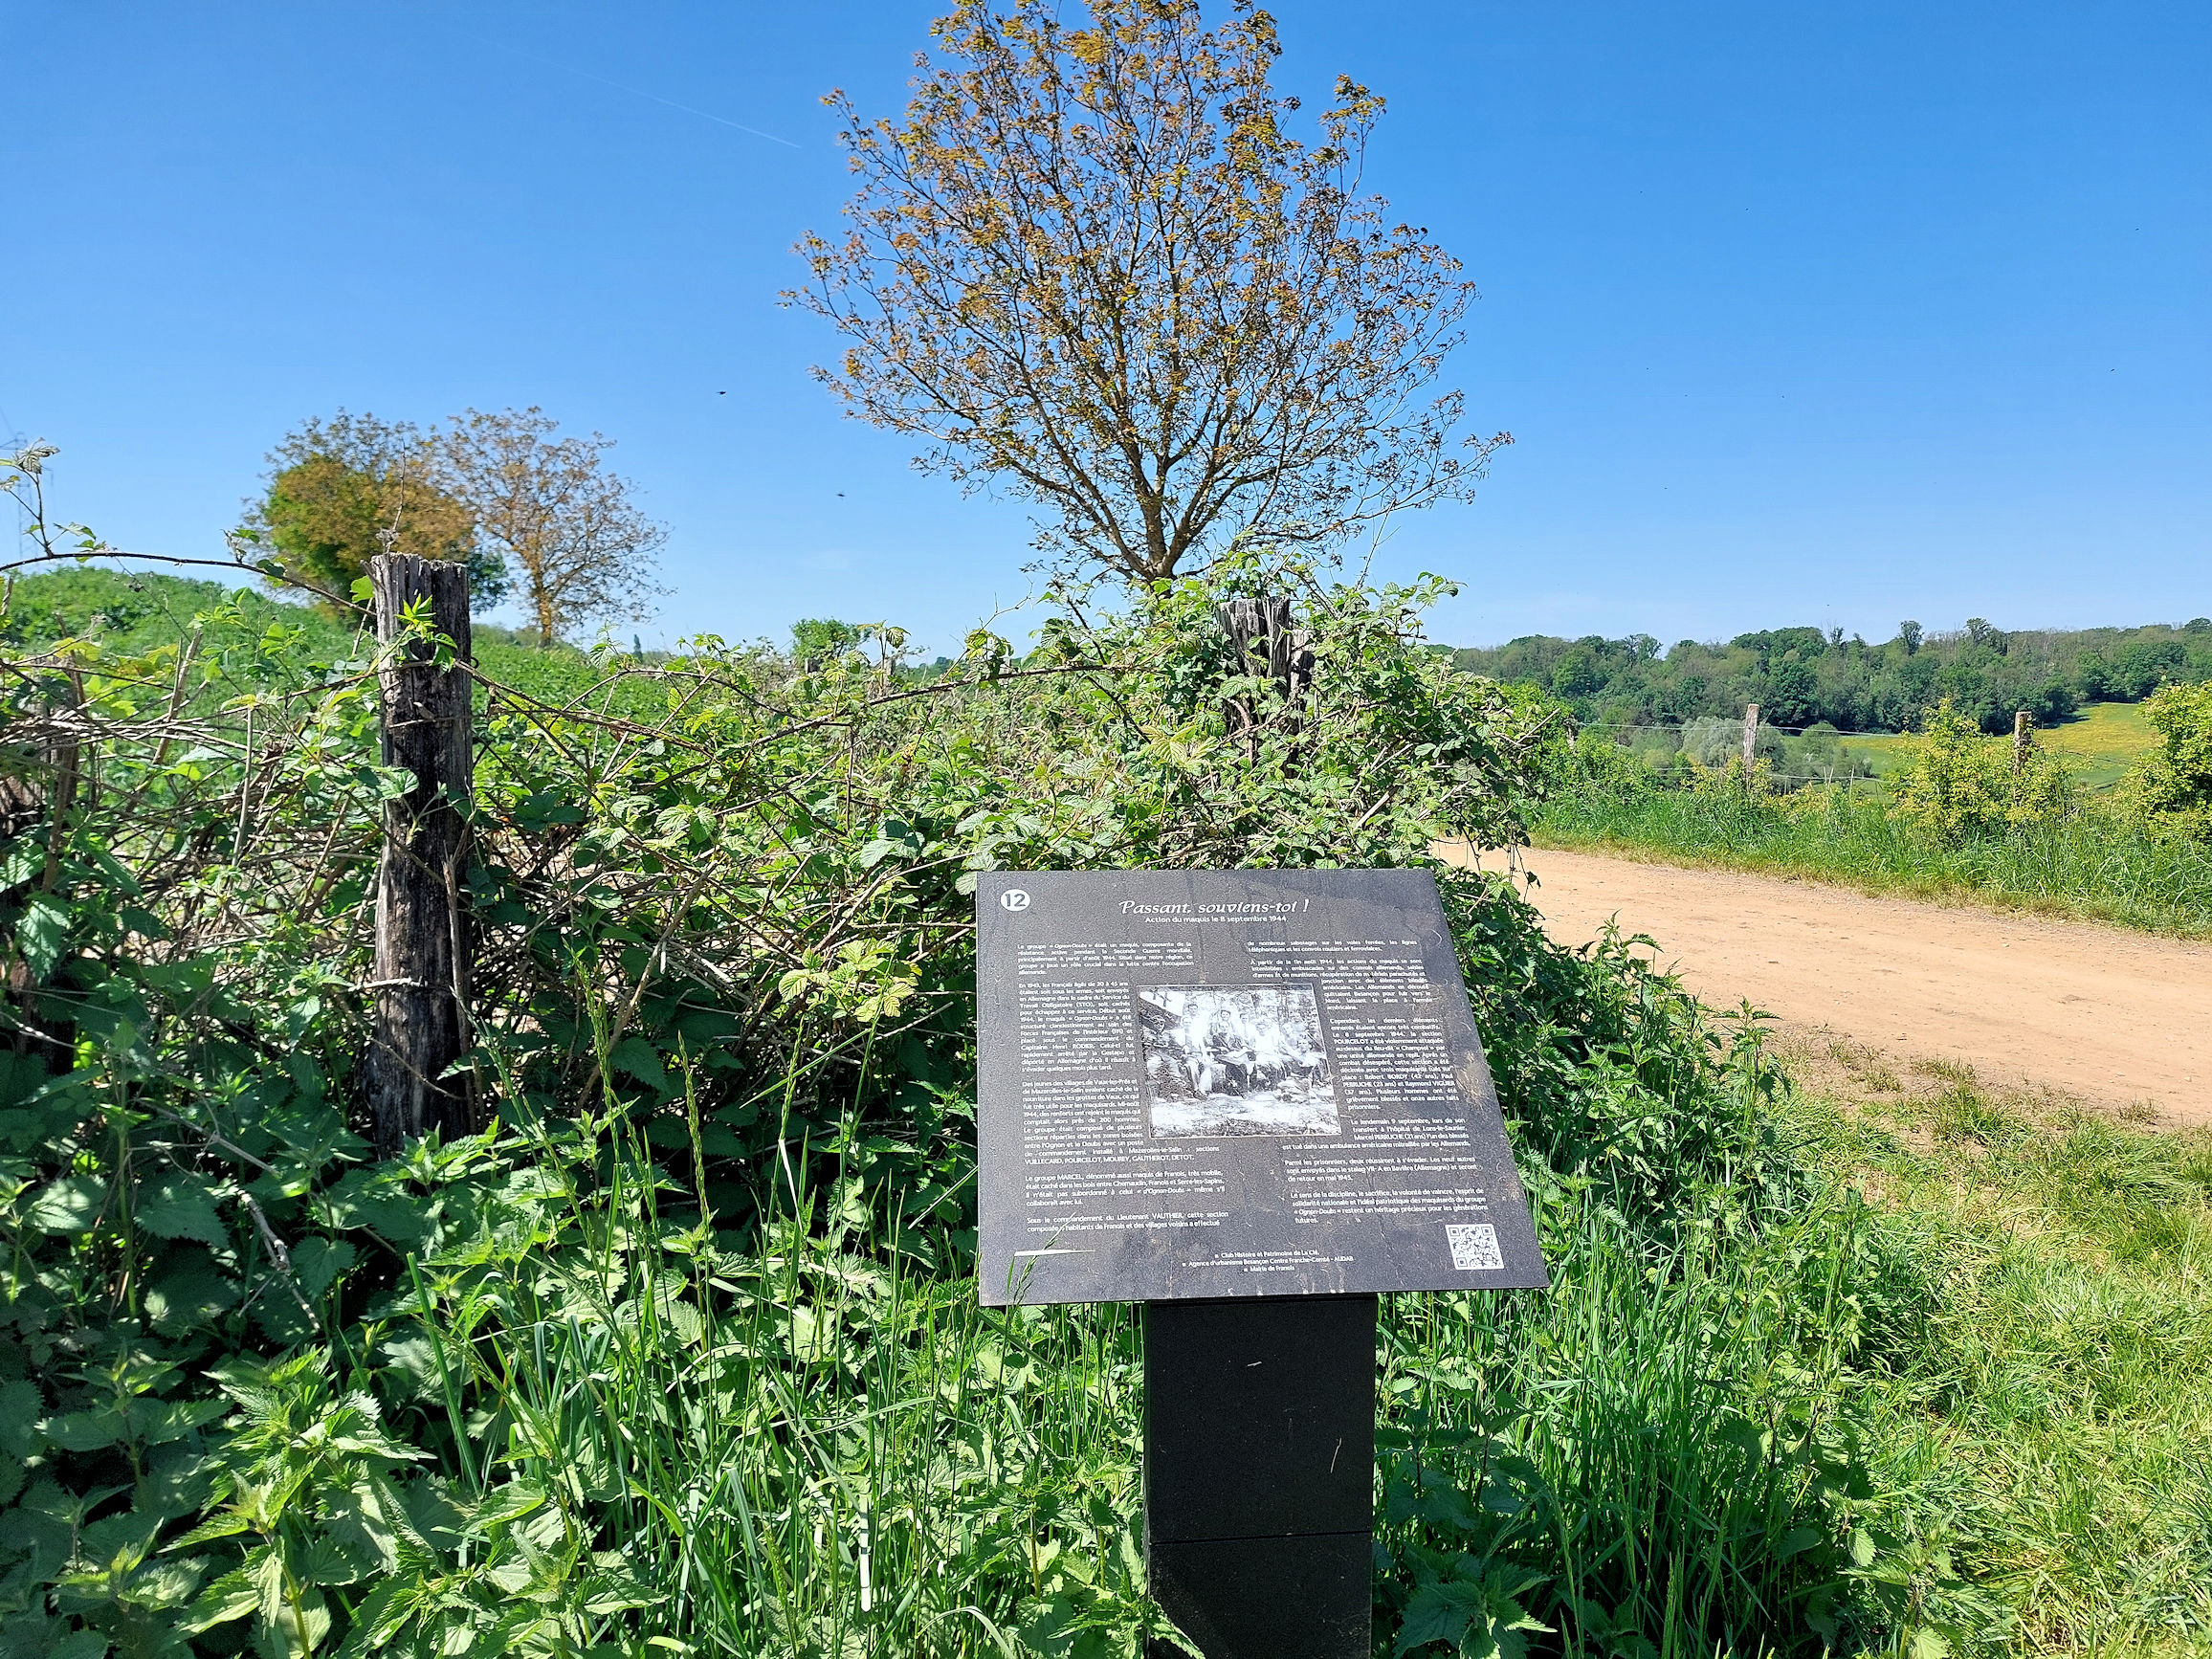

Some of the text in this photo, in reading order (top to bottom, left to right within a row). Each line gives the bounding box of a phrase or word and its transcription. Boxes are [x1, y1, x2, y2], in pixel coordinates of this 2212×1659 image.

[1006, 894, 1026, 907] 12
[1118, 898, 1310, 916] Passant, souviens-toi !
